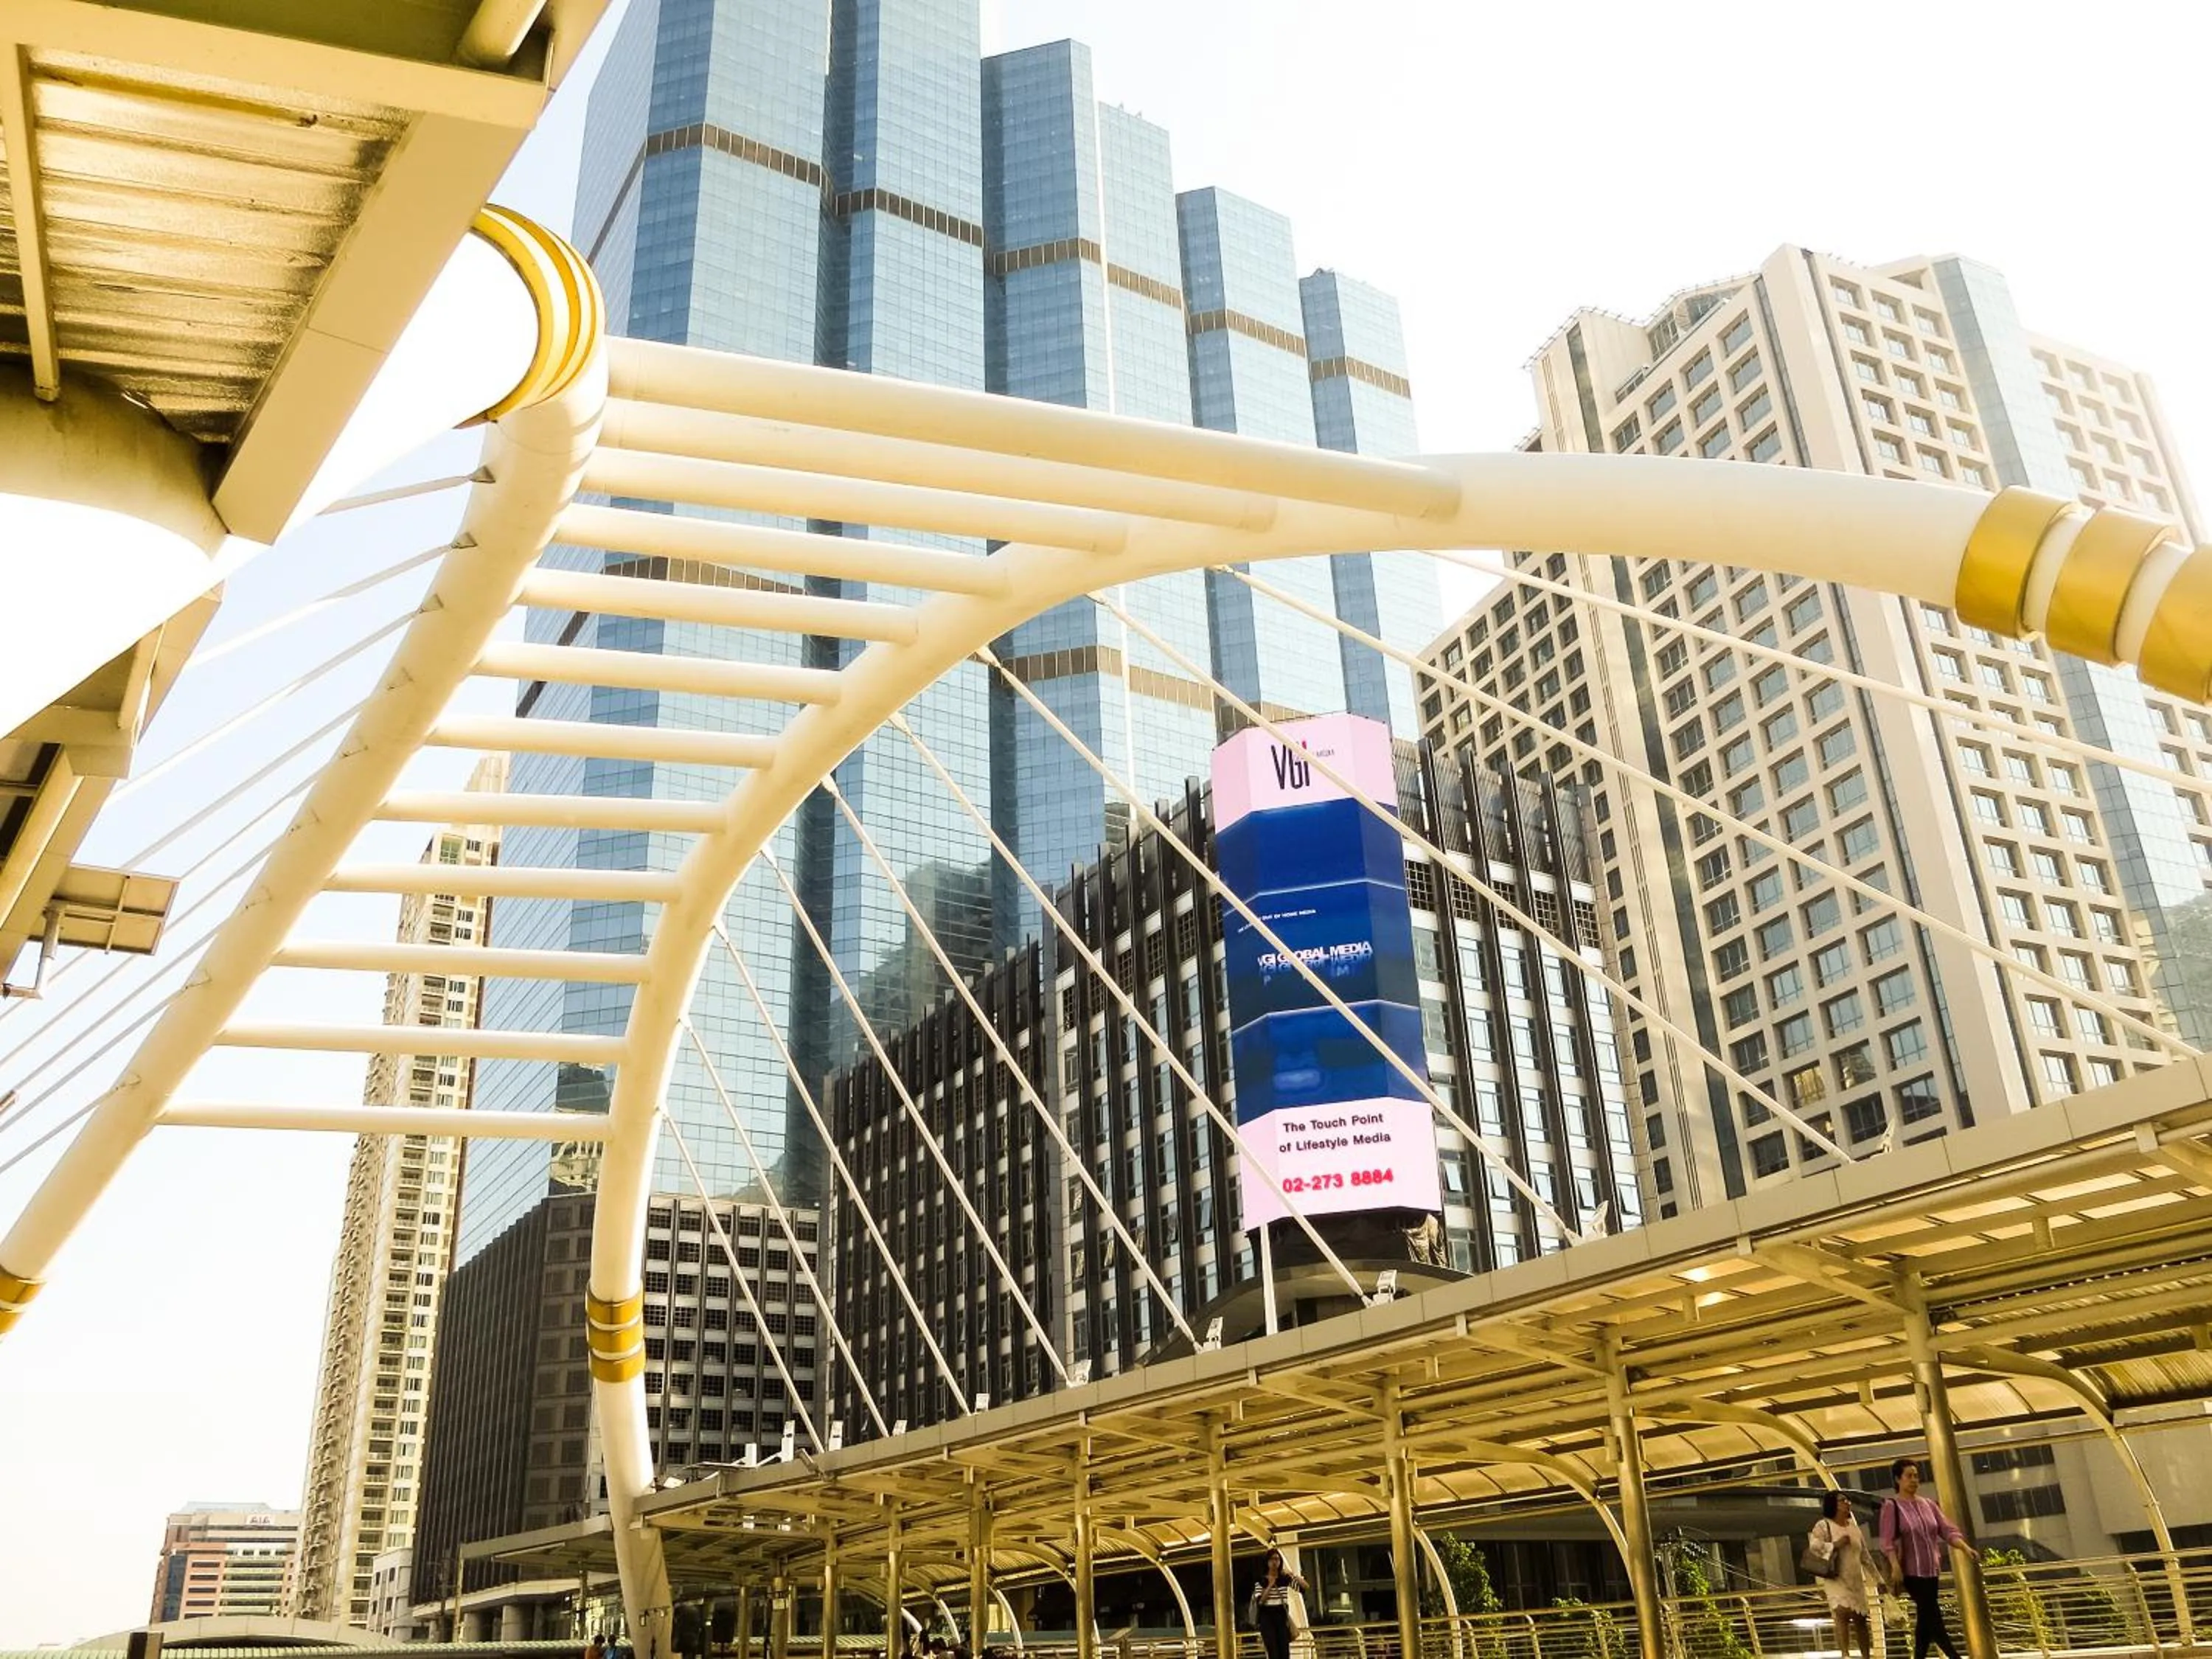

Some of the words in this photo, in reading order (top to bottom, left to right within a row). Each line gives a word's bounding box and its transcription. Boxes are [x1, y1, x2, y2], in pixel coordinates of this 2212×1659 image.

[1277, 946, 1329, 965] GOBAL
[1329, 940, 1374, 956] MEDIA
[1283, 1122, 1306, 1133] The
[1310, 1117, 1346, 1130] Touch
[1352, 1113, 1383, 1125] Point
[1279, 1142, 1291, 1152] of
[1295, 1136, 1348, 1152] Lifestyle
[1353, 1133, 1391, 1145] Media
[1282, 1173, 1344, 1193] 02-273
[1350, 1168, 1394, 1186] 8884
